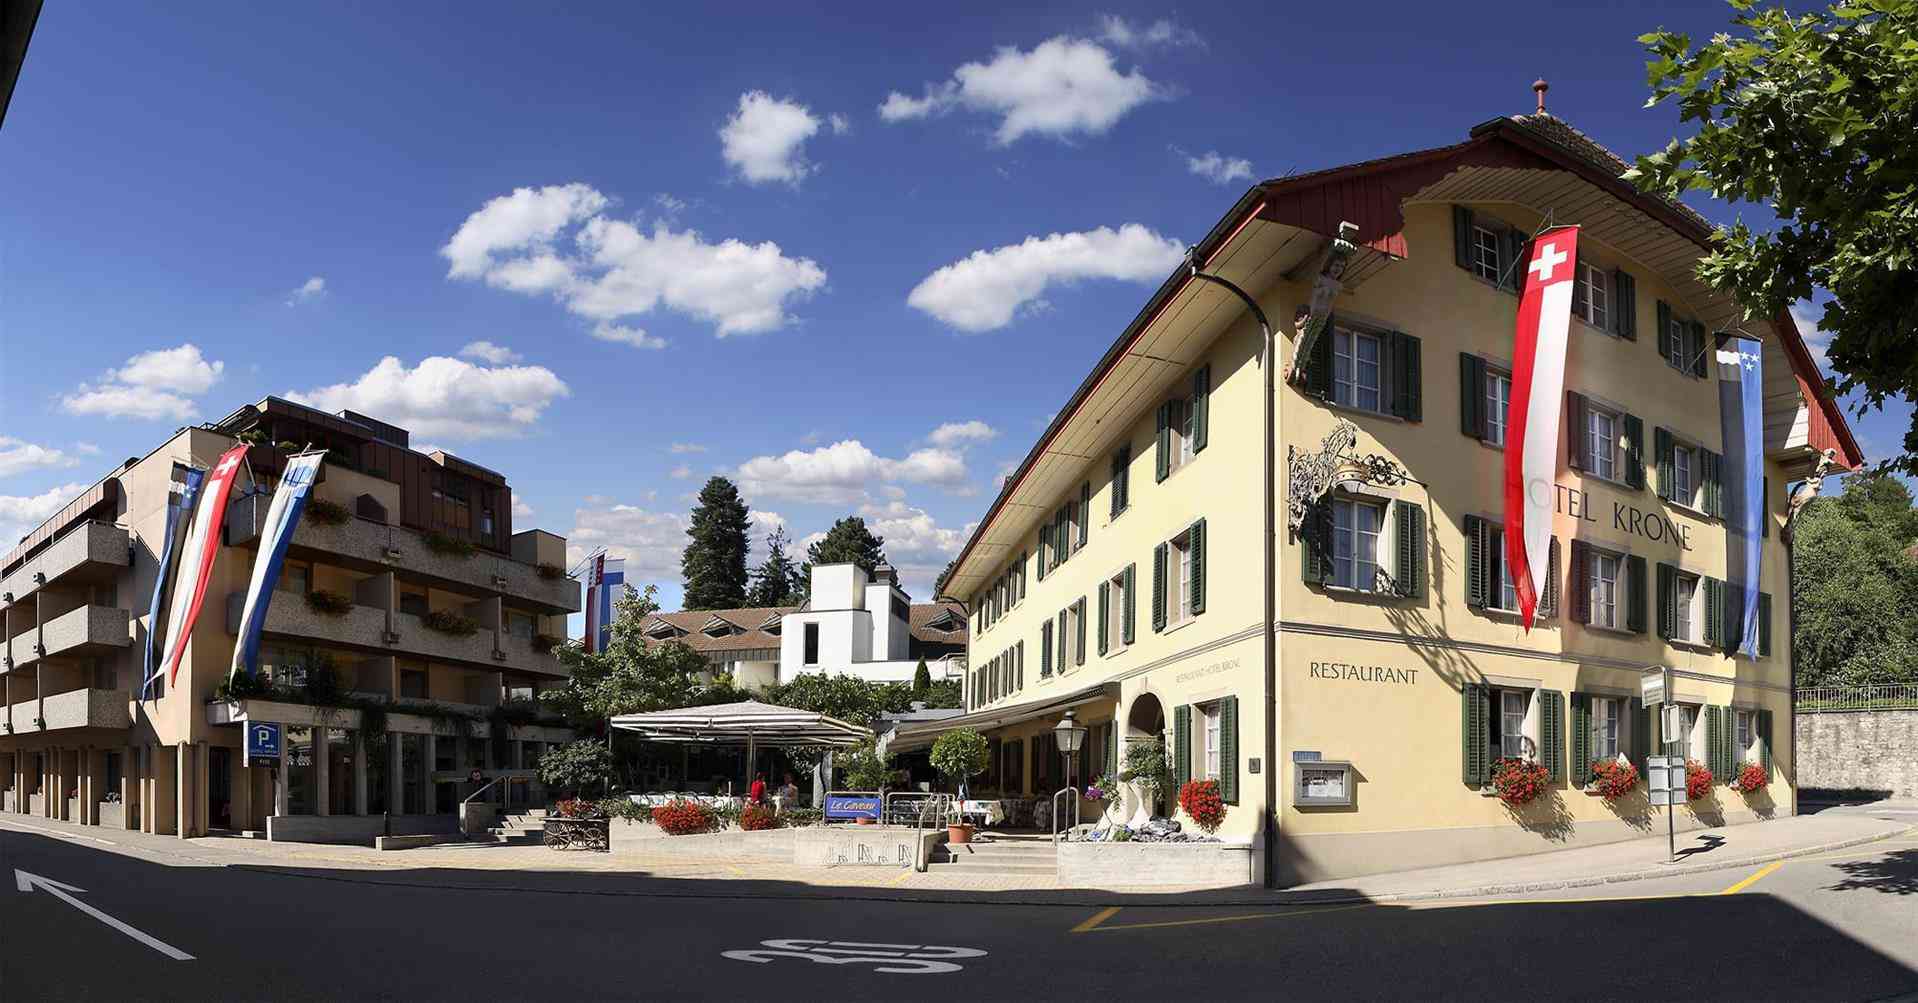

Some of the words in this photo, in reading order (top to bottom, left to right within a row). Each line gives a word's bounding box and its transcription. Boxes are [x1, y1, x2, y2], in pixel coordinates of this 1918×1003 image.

[1613, 502, 1693, 551] KRONE
[1309, 661, 1419, 685] RESTAURANT
[258, 730, 269, 746] P
